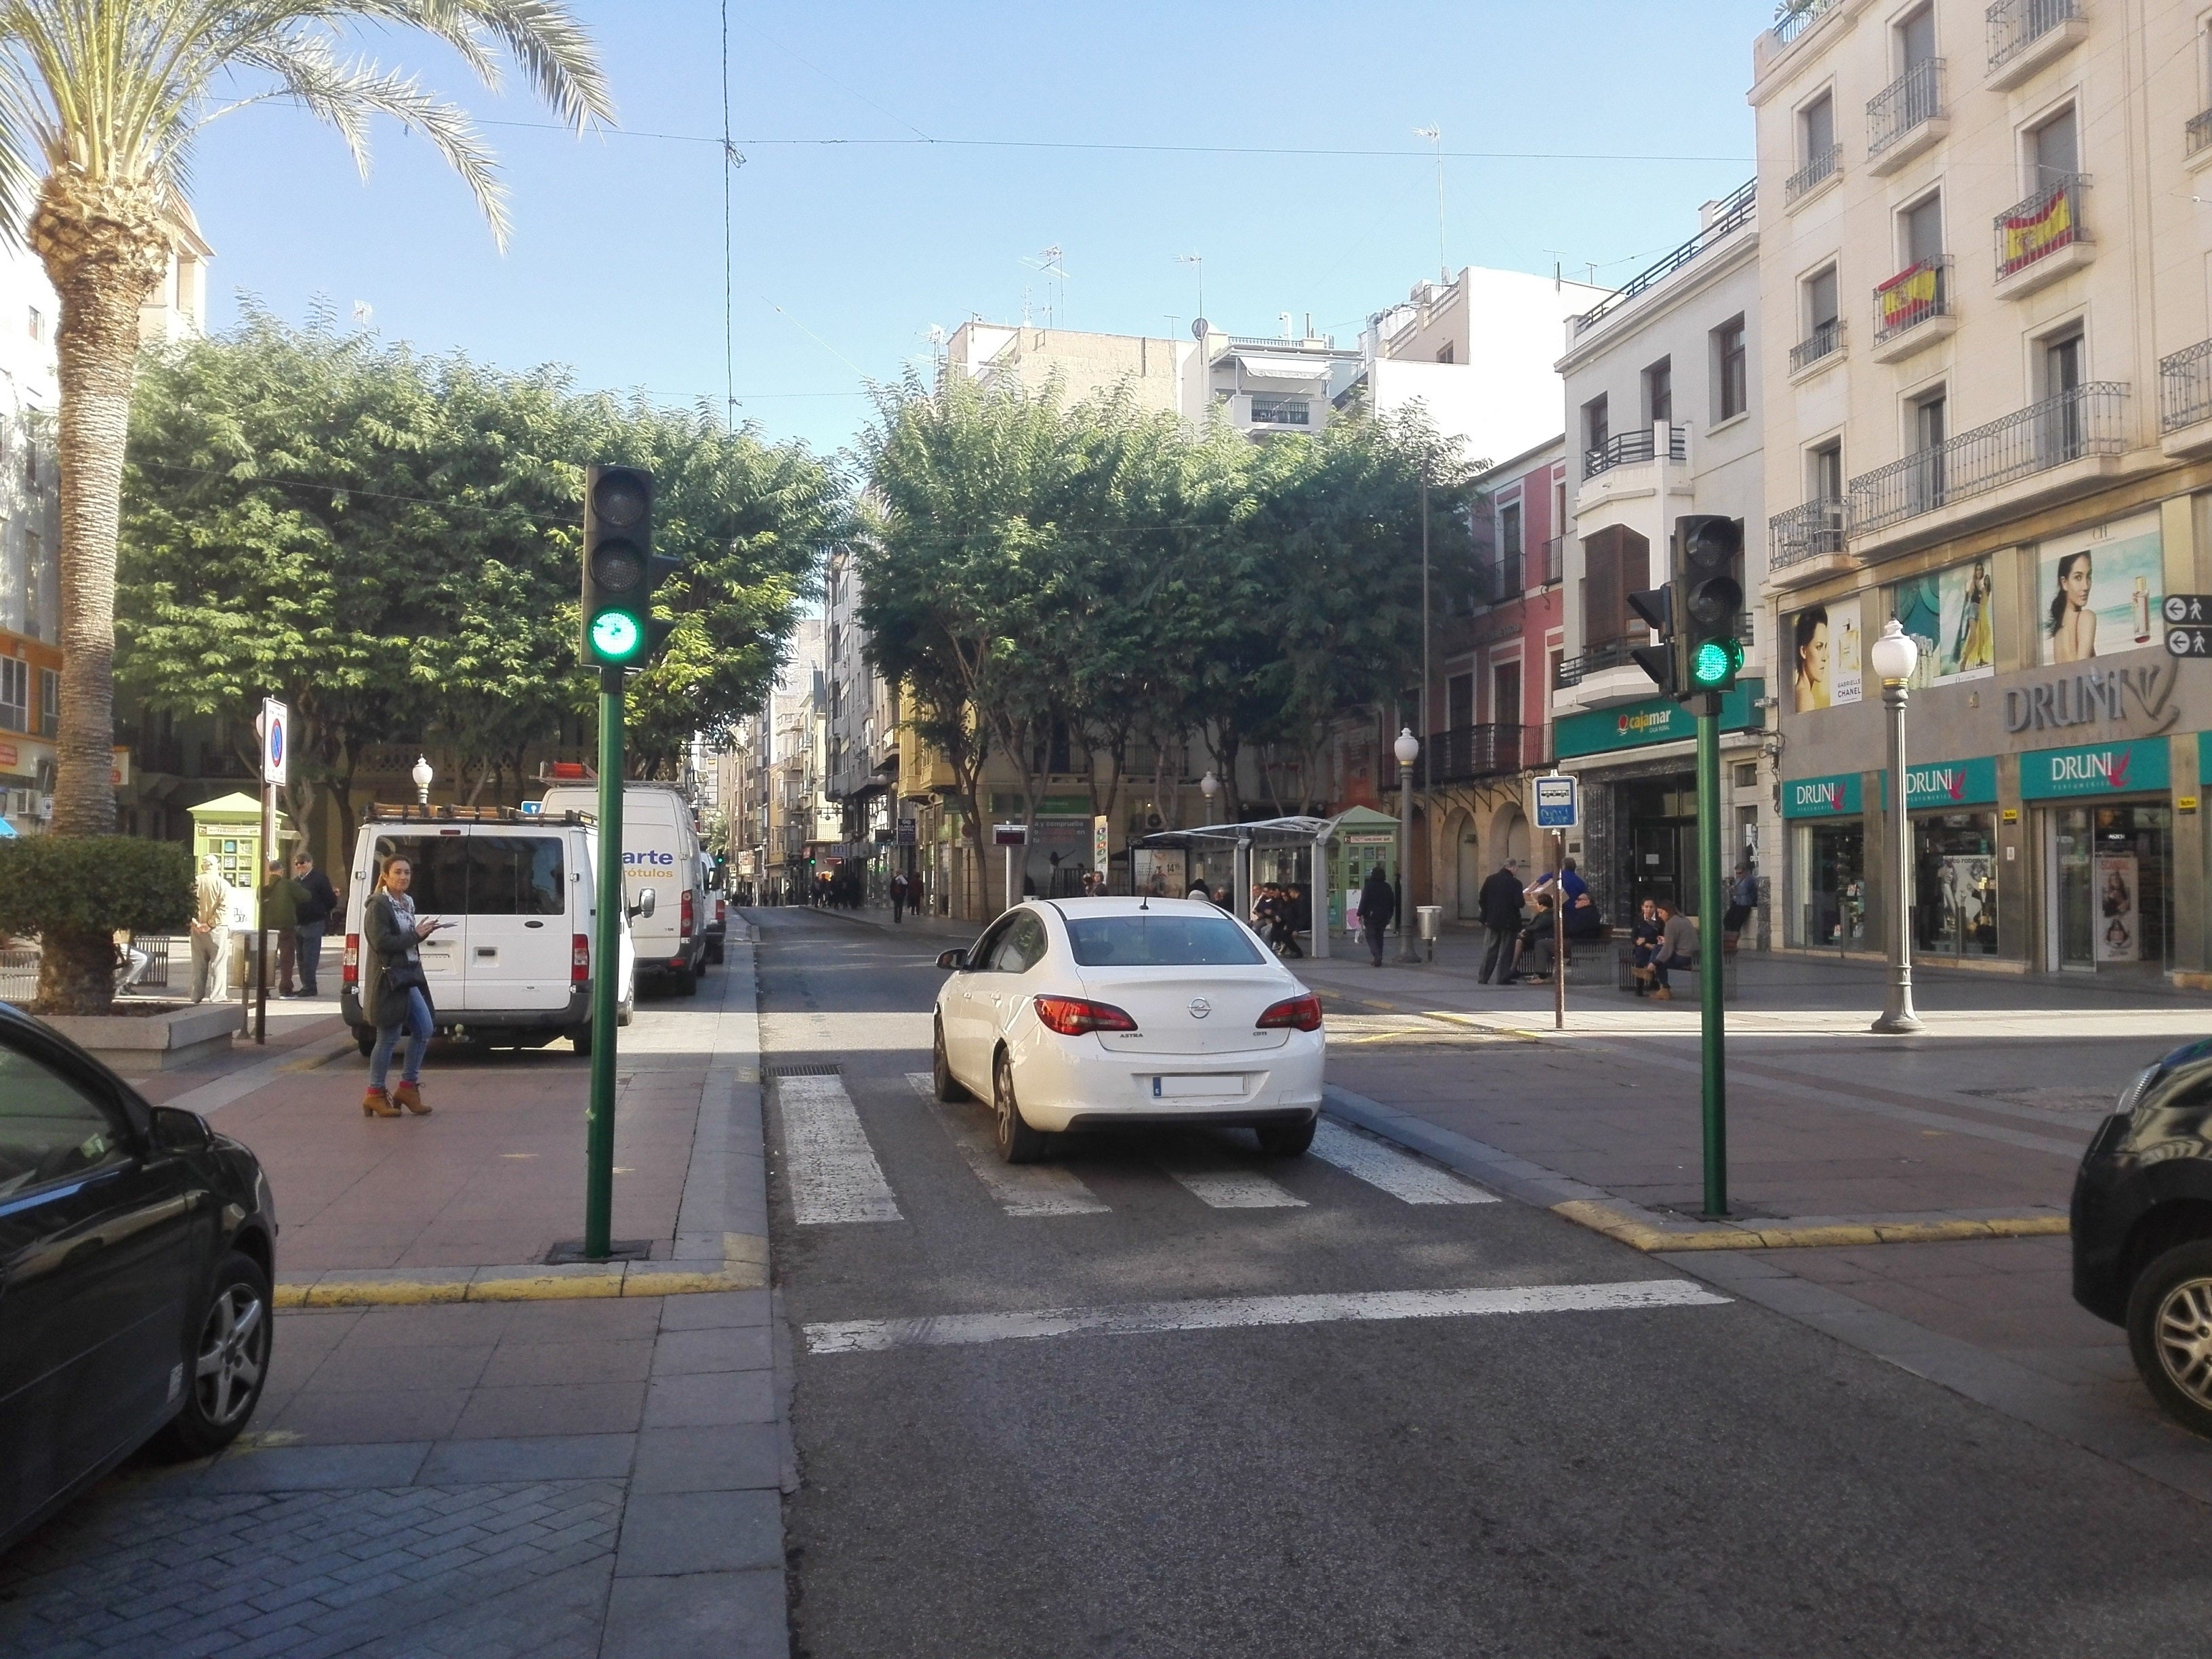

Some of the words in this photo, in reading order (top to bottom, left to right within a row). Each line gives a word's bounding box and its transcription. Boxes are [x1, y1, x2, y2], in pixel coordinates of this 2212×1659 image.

[1837, 687, 1861, 698] CHANEL
[1838, 678, 1861, 688] GABRIELLE
[2004, 668, 2125, 733] DRUNI
[1629, 710, 1671, 733] cajamar
[2051, 752, 2113, 781] DRUNI
[1906, 769, 1952, 794] DRUNI
[1797, 782, 1835, 804] DRUNI
[622, 850, 673, 865] arte
